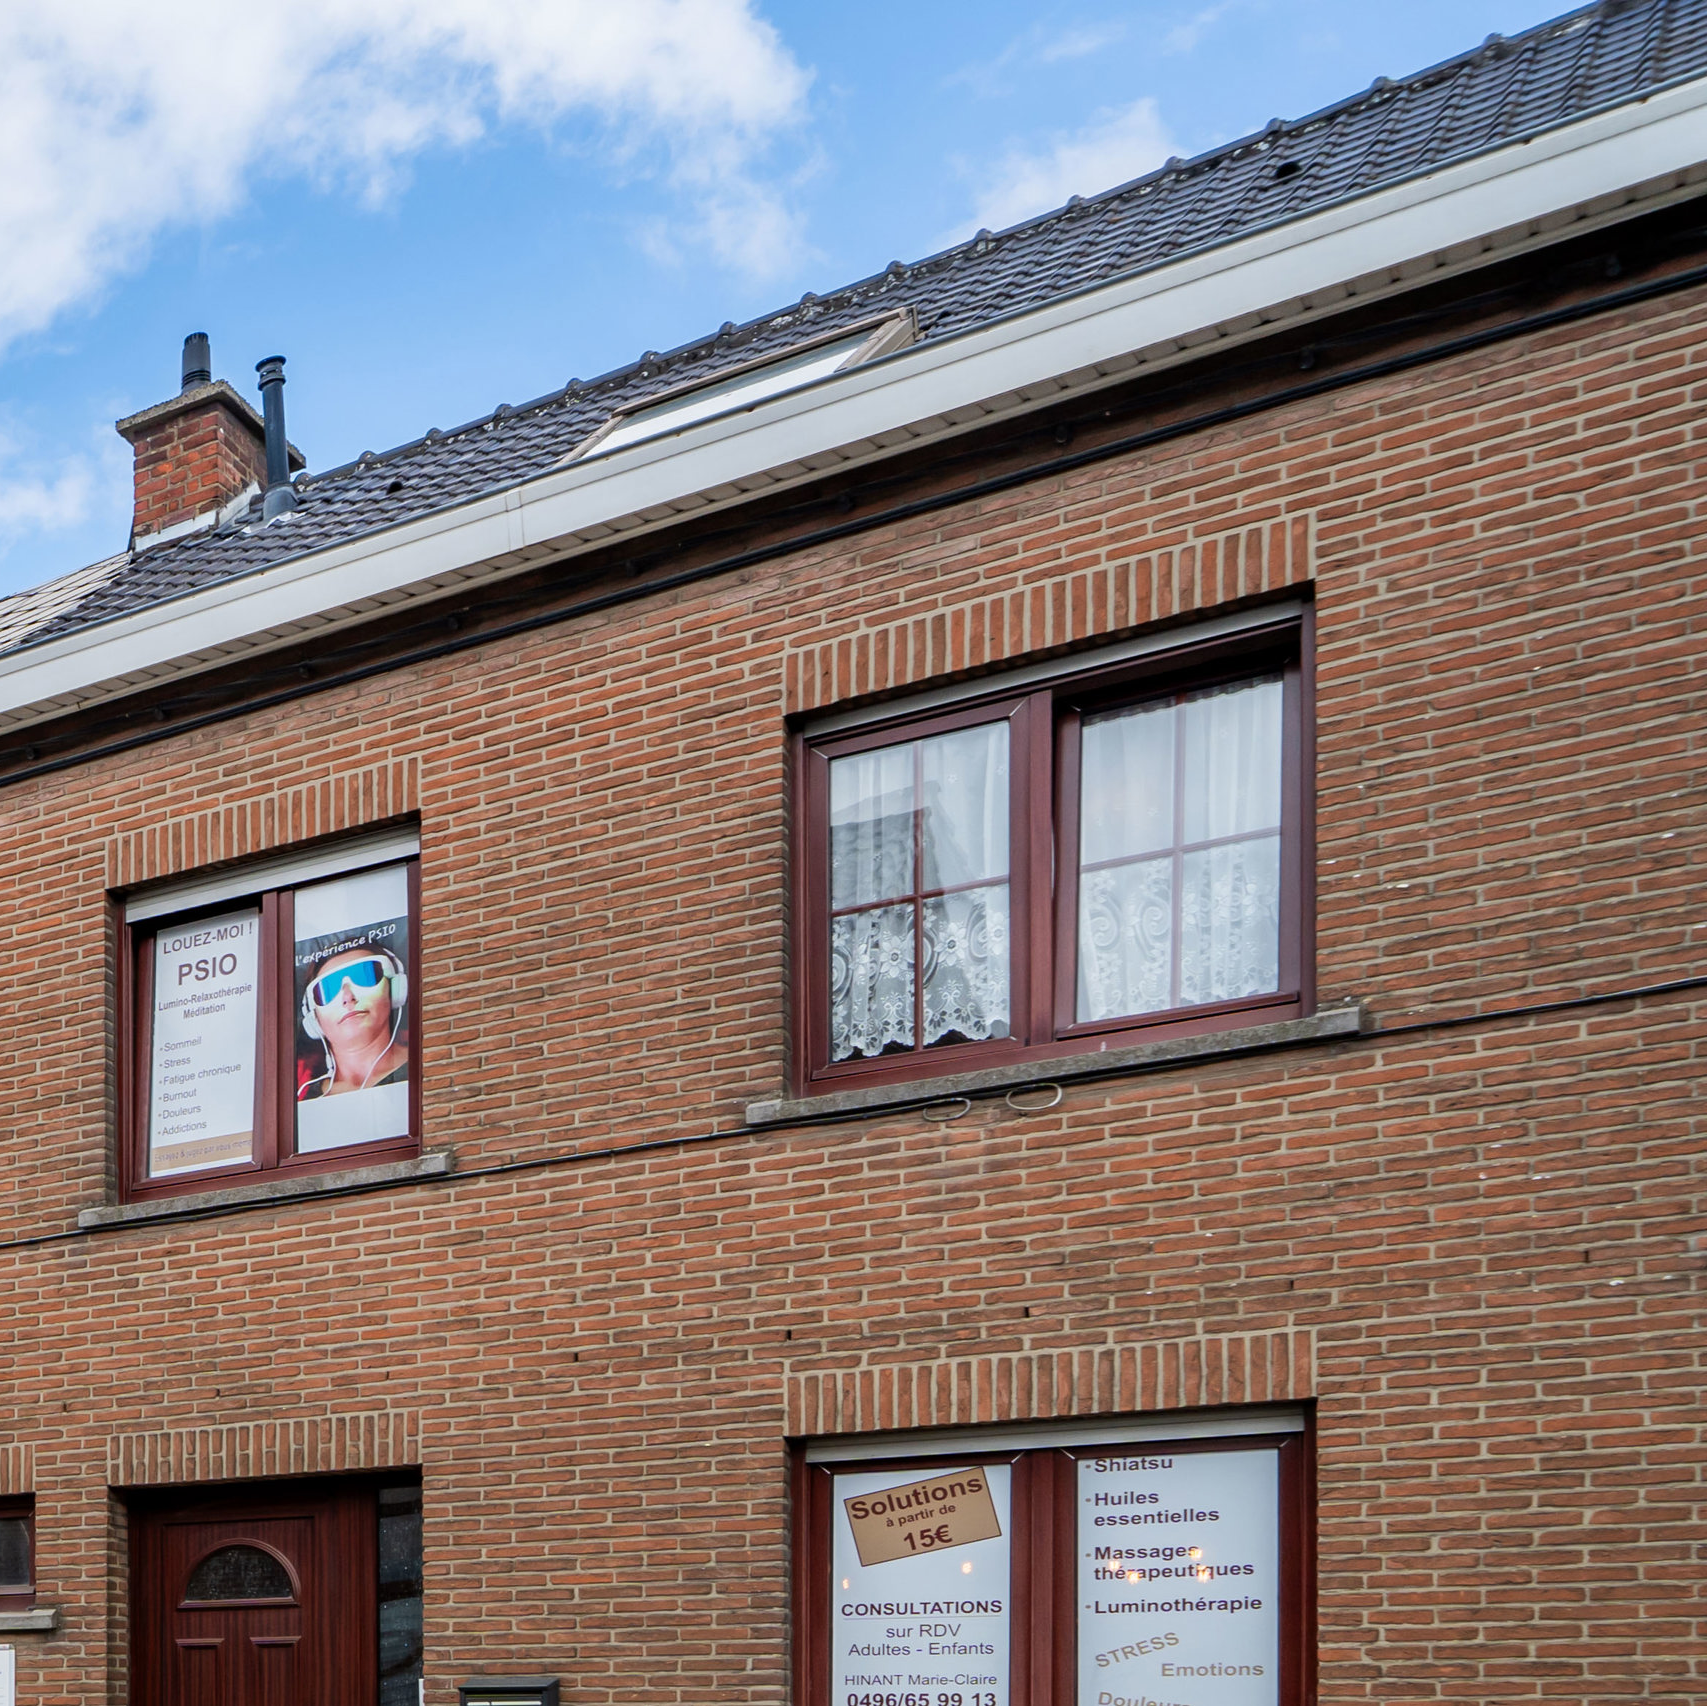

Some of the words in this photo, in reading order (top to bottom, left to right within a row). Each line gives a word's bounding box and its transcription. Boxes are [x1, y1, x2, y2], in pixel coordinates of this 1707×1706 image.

[163, 923, 244, 954] LOUEZ-MOI
[295, 936, 366, 966] l'expérience
[368, 923, 396, 944] PSIO
[178, 953, 237, 986] PSIO
[158, 983, 252, 1011] Lumino-Relaxothérapie
[183, 1003, 226, 1019] Méditation
[164, 1036, 202, 1052] Sommeil
[163, 1057, 191, 1069] Stress
[163, 1072, 196, 1085] Fatigue
[198, 1063, 241, 1079] chronique
[163, 1088, 197, 1102] Burnout
[162, 1105, 202, 1119] Douleurs
[162, 1121, 207, 1136] Addictions
[1094, 1458, 1173, 1472] Shiatsu
[851, 1478, 983, 1520] Solutions
[1094, 1491, 1159, 1506] Huiles
[886, 1517, 894, 1528] à
[898, 1508, 935, 1528] partir
[939, 1503, 956, 1516] de
[1094, 1508, 1220, 1526] essentielles
[903, 1524, 953, 1551] 15€
[1094, 1545, 1201, 1561] Massages
[1094, 1563, 1255, 1582] thérapeutiques
[841, 1600, 1002, 1616] CONSULTATIONS
[1094, 1596, 1263, 1614] Luminothérapie
[886, 1627, 913, 1639] sur
[919, 1623, 961, 1638] RDV
[848, 1643, 911, 1656] Adultes
[928, 1642, 994, 1656] Enfants
[1095, 1632, 1180, 1668] STRESS
[1161, 1662, 1264, 1677] Emotions
[844, 1674, 903, 1686] HINANT
[908, 1673, 997, 1686] Marie-Claire
